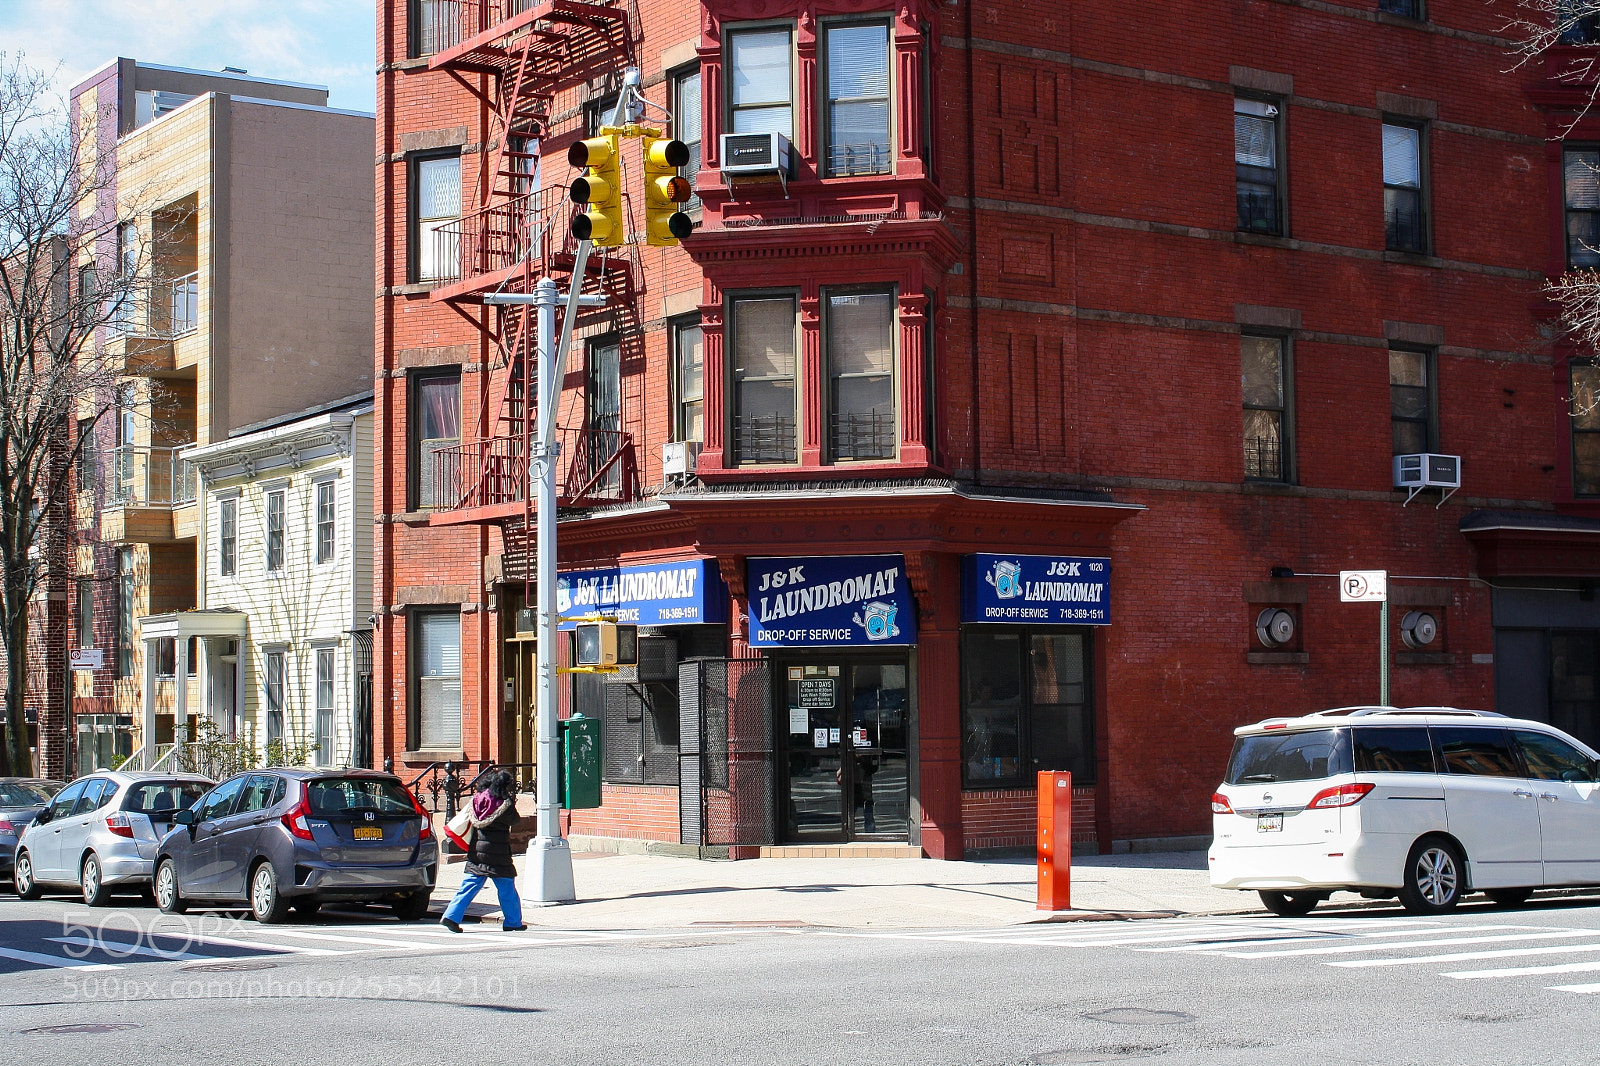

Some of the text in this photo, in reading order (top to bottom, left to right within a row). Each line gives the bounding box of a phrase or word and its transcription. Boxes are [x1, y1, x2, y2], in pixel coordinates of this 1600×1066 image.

[1047, 562, 1103, 576] J&K 1020
[574, 568, 697, 606] J&K LAUNDROMAT
[758, 566, 806, 592] J&K
[759, 567, 898, 622] LAUNDROMAT
[1024, 581, 1103, 602] LAUNDROMAT
[615, 608, 640, 621] SERVICE
[658, 607, 698, 620] 718-369-1511
[985, 607, 1104, 619] DROP-OFF SERVICE 718-369-1511
[757, 628, 852, 641] DROP-OFF SERVICE
